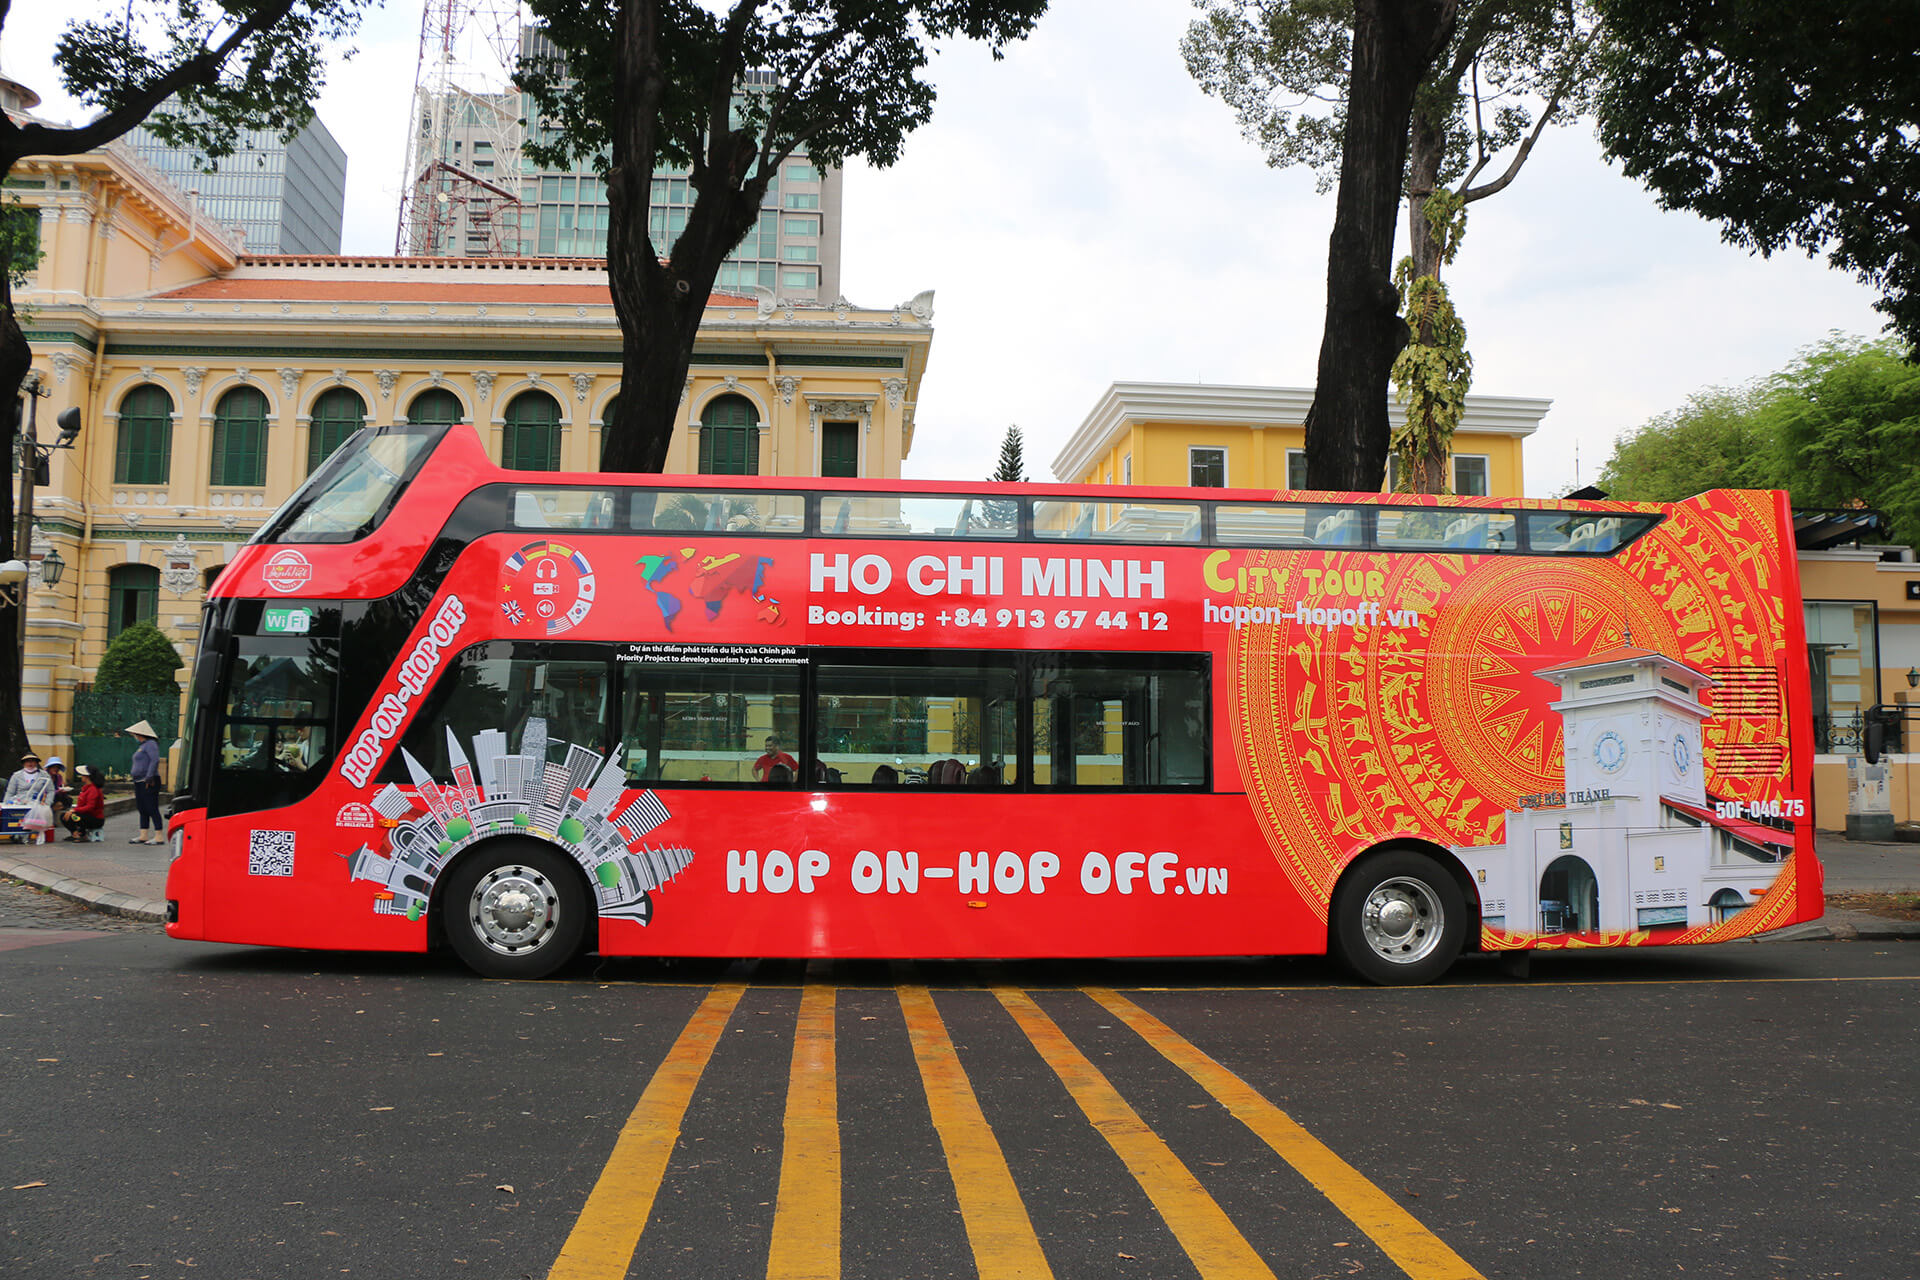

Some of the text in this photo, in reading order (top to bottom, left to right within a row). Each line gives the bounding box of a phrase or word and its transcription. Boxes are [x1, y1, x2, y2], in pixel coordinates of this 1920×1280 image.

[809, 552, 1165, 599] HO CHI MINH
[1302, 568, 1386, 598] TOUR
[808, 605, 1168, 631] Booking: +84 913 67 44 12
[1203, 598, 1419, 632] hopon-hopoff.vn
[616, 654, 643, 663] Priority
[644, 655, 671, 663] Project
[680, 655, 710, 664] develop
[740, 656, 750, 664] by
[750, 656, 763, 664] the
[682, 646, 700, 654] phát
[730, 647, 744, 655] lịch
[341, 730, 382, 788] HOP
[398, 637, 439, 694] HOP
[430, 595, 466, 646] OFF
[1715, 799, 1805, 820] 50F-046.75
[726, 849, 830, 894] HOP
[851, 850, 1060, 895] ON-HOP
